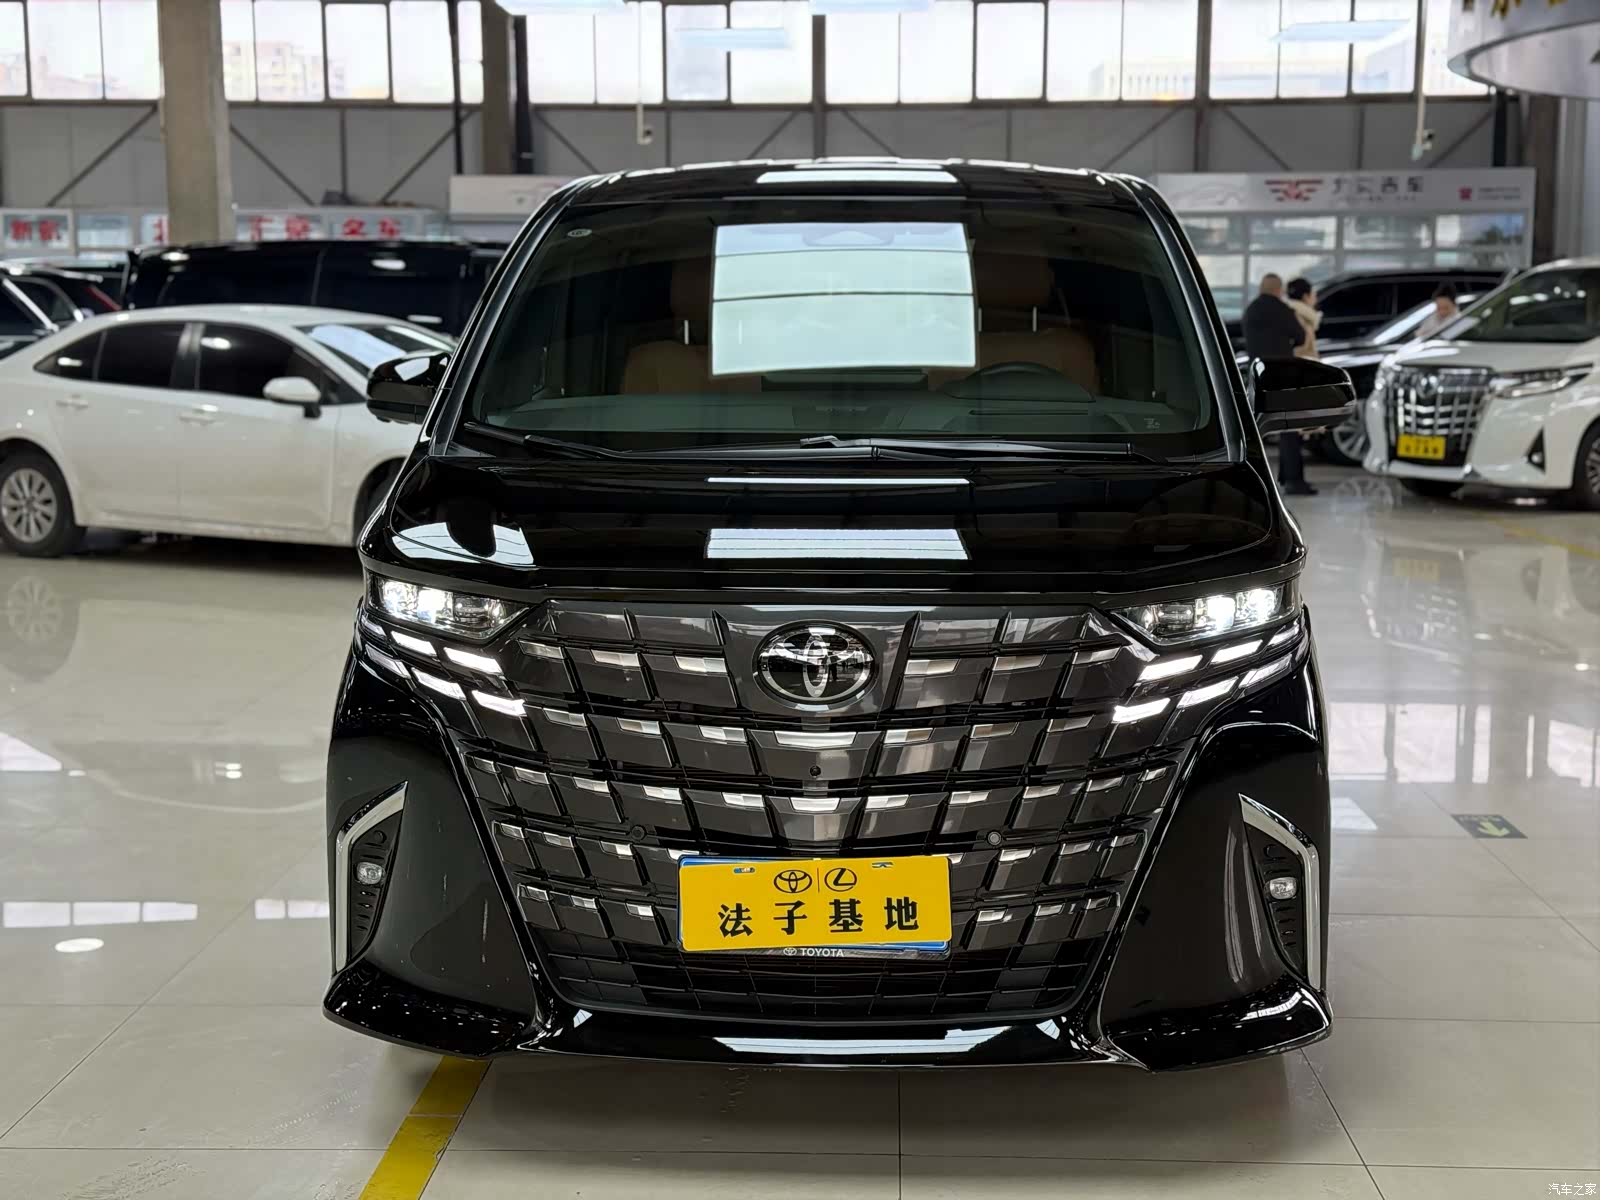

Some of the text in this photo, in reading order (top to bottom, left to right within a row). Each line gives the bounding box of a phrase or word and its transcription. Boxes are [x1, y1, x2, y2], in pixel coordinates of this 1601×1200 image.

[718, 896, 919, 938] 法子基地
[801, 947, 845, 958] TOYOTA
